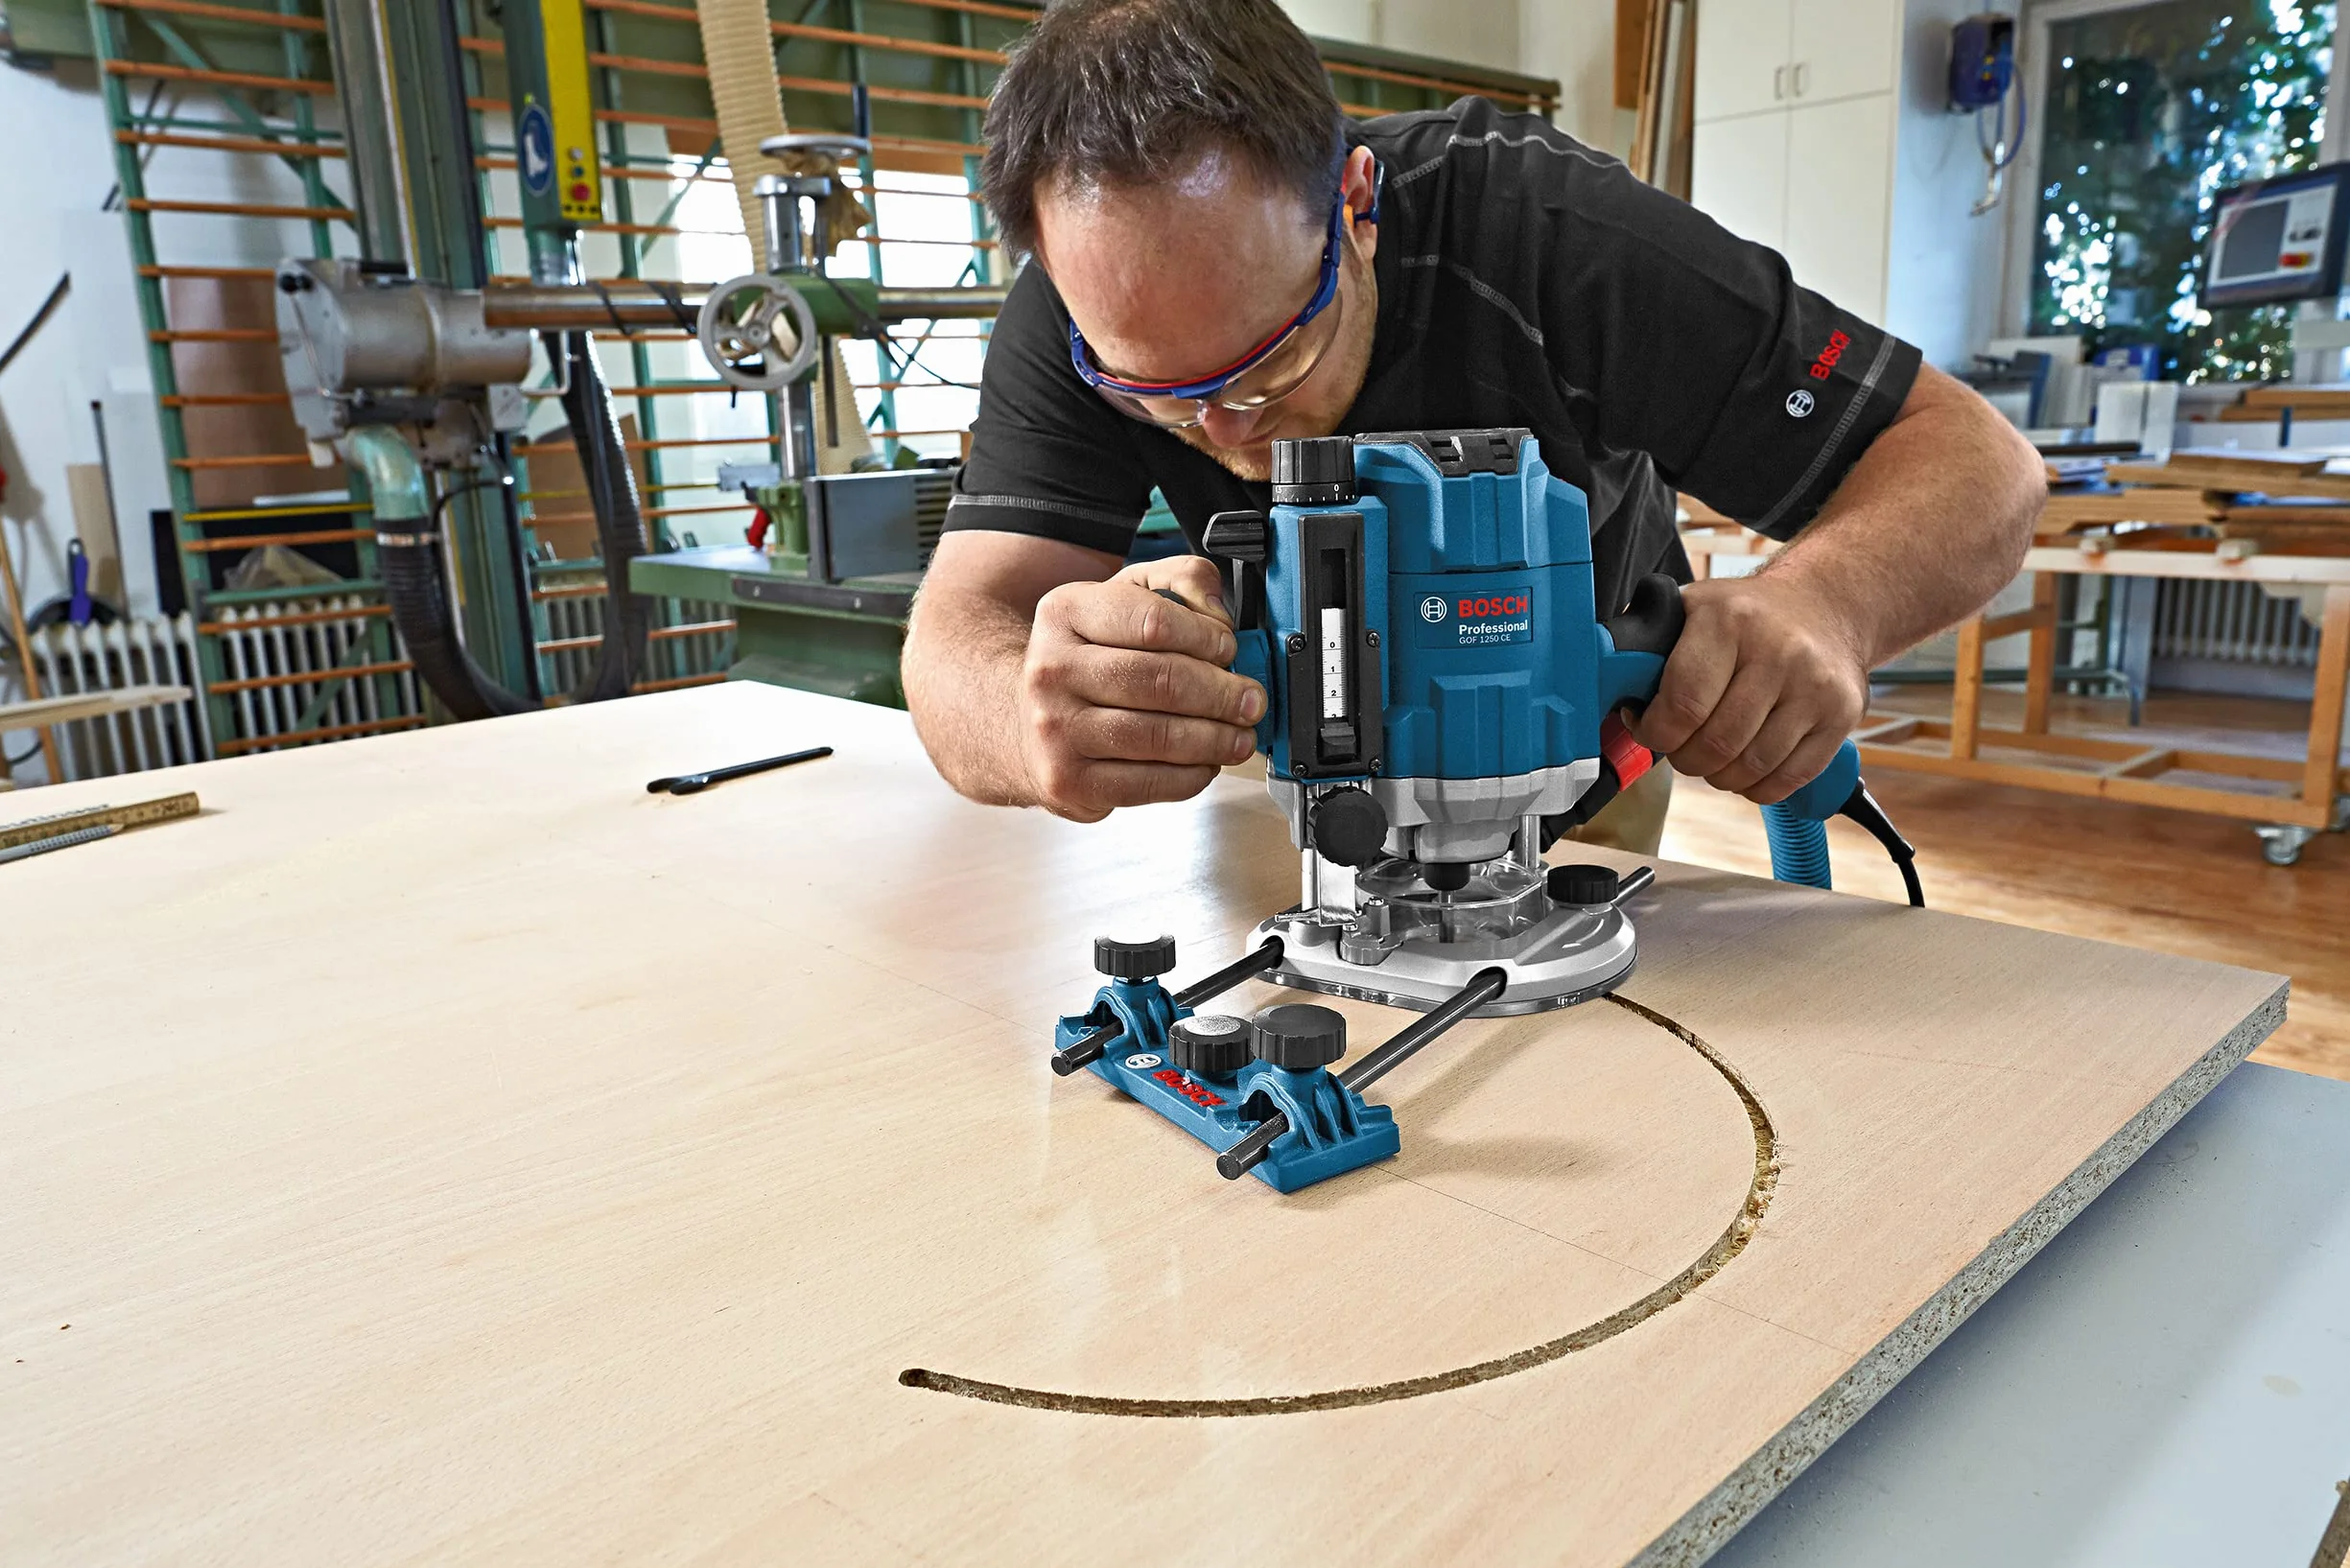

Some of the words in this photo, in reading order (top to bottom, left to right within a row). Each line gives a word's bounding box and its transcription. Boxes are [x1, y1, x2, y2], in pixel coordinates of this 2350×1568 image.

[1458, 596, 1528, 618] BOSCH
[1459, 620, 1528, 635] Professional
[1459, 636, 1477, 644] GOF
[1480, 635, 1499, 644] 1250
[1500, 633, 1511, 642] CE
[1152, 1069, 1228, 1108] BOSCH
